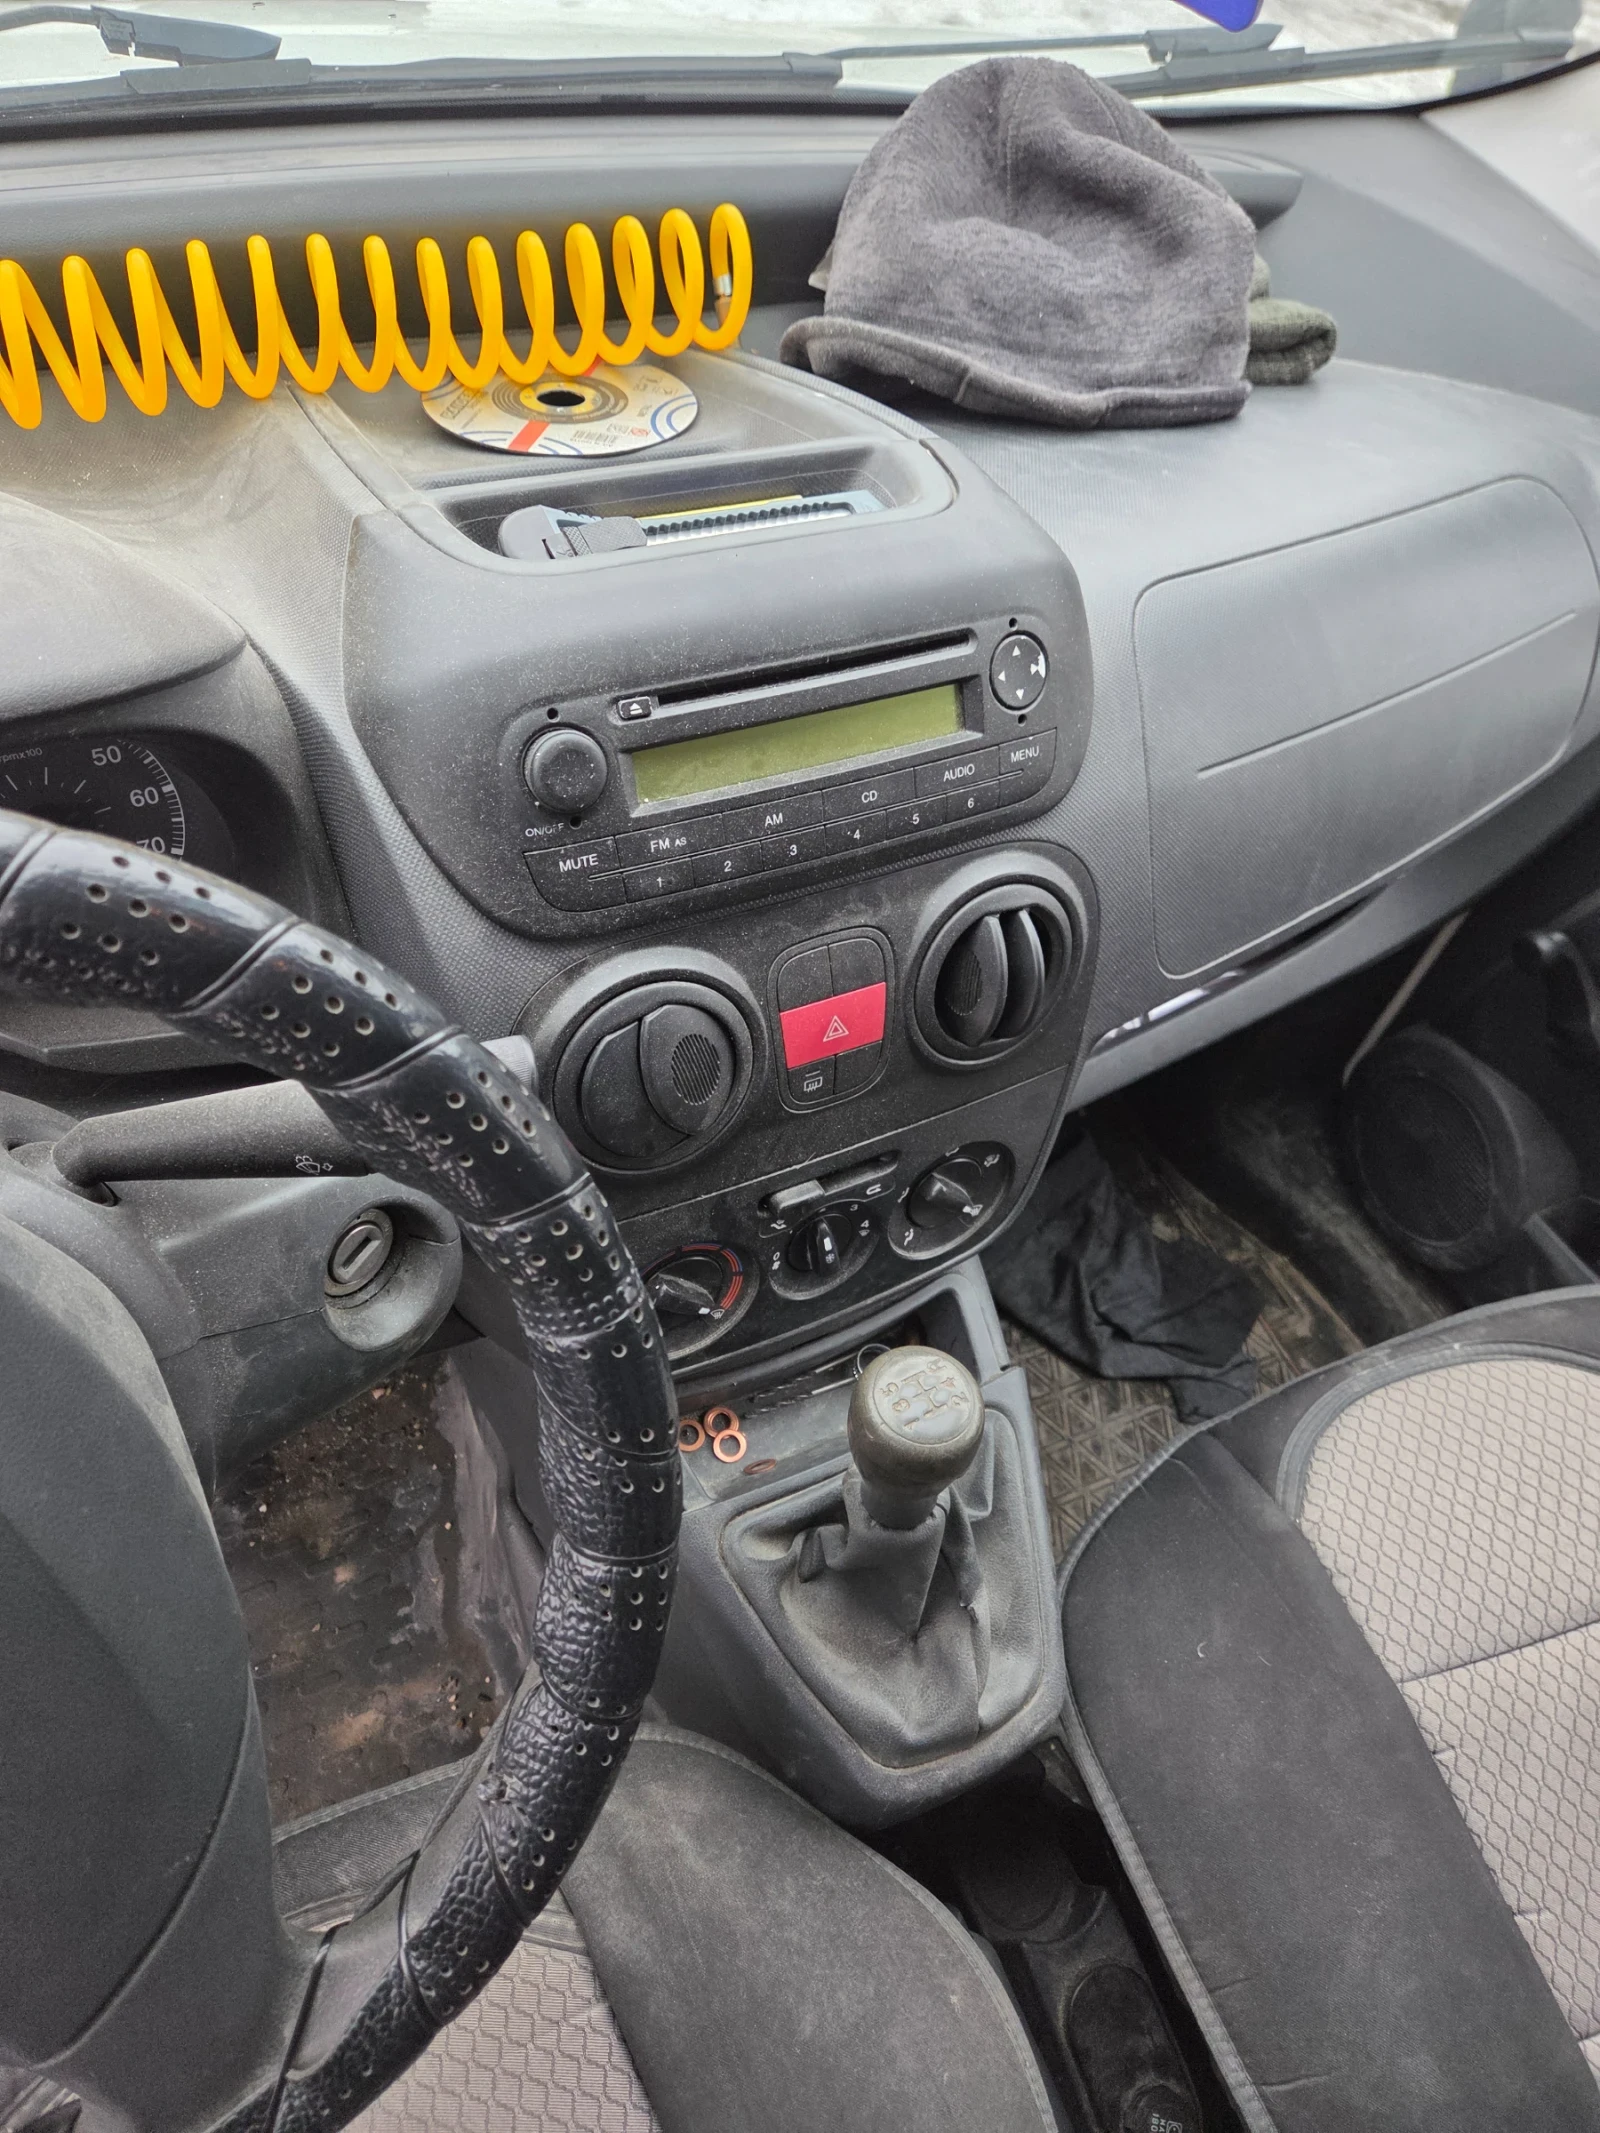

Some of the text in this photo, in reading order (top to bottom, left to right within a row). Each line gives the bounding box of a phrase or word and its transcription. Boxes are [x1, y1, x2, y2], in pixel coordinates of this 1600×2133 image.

[91, 745, 122, 766] 50
[1010, 745, 1040, 763] MENU
[943, 763, 976, 782] AUDIO
[129, 786, 159, 807] 60
[861, 790, 878, 804] CD
[967, 797, 975, 808] 6
[764, 812, 783, 827] AM
[912, 813, 920, 825] 5
[525, 822, 565, 837] ON/OFF
[853, 828, 861, 840] 4
[650, 836, 688, 852] FM AS
[789, 844, 798, 856] 3
[558, 853, 599, 872] MUTE
[723, 860, 732, 872] 2
[656, 876, 663, 888] 1
[849, 1203, 859, 1211] 3
[860, 1219, 870, 1228] 4
[772, 1251, 780, 1261] 0
